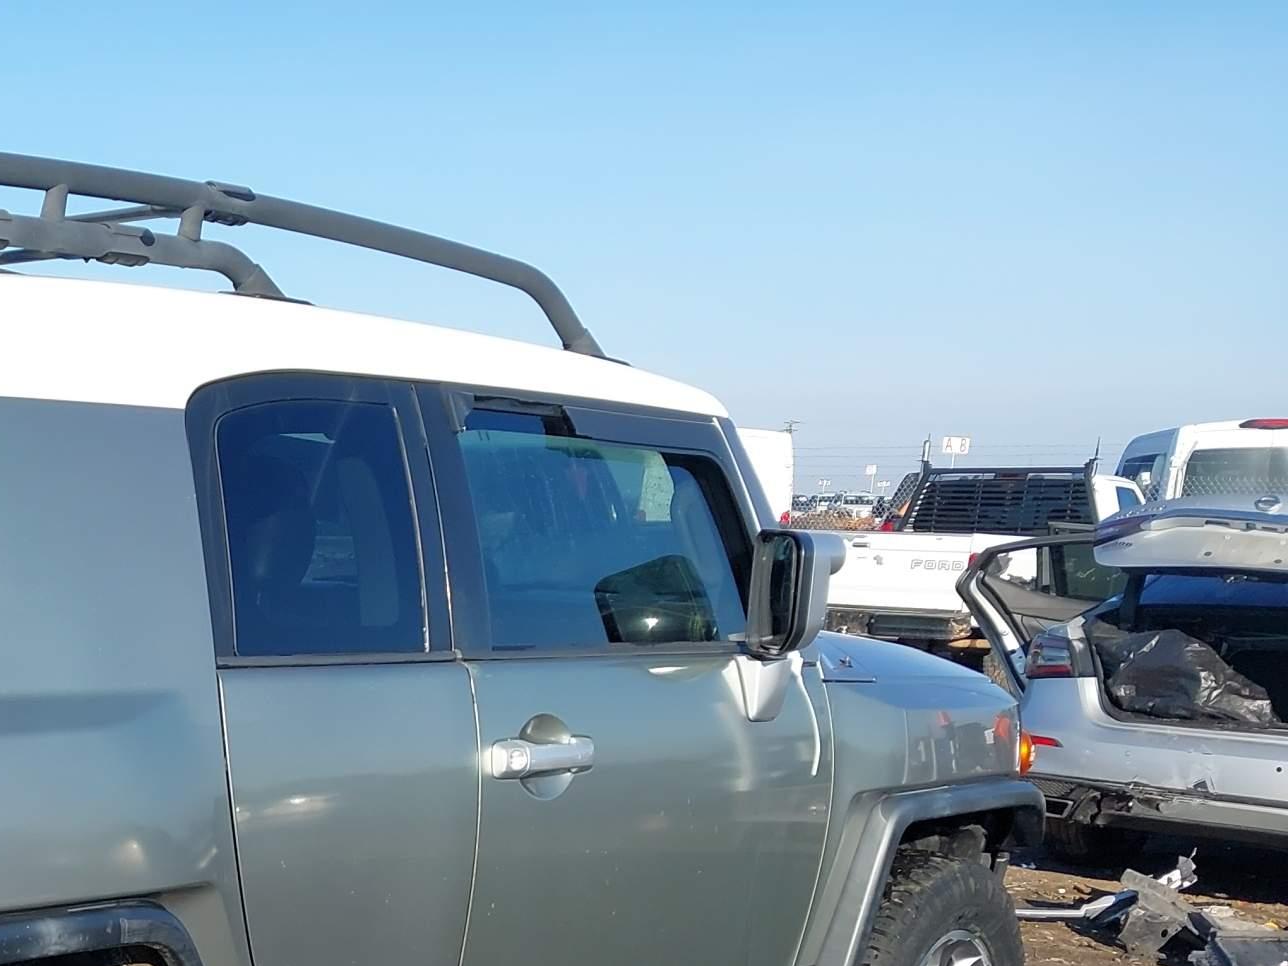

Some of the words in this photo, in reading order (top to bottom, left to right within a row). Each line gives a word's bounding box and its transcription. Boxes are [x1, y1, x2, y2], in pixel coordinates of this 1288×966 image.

[945, 438, 953, 451] A
[959, 438, 967, 452] B
[910, 559, 964, 571] FORD
